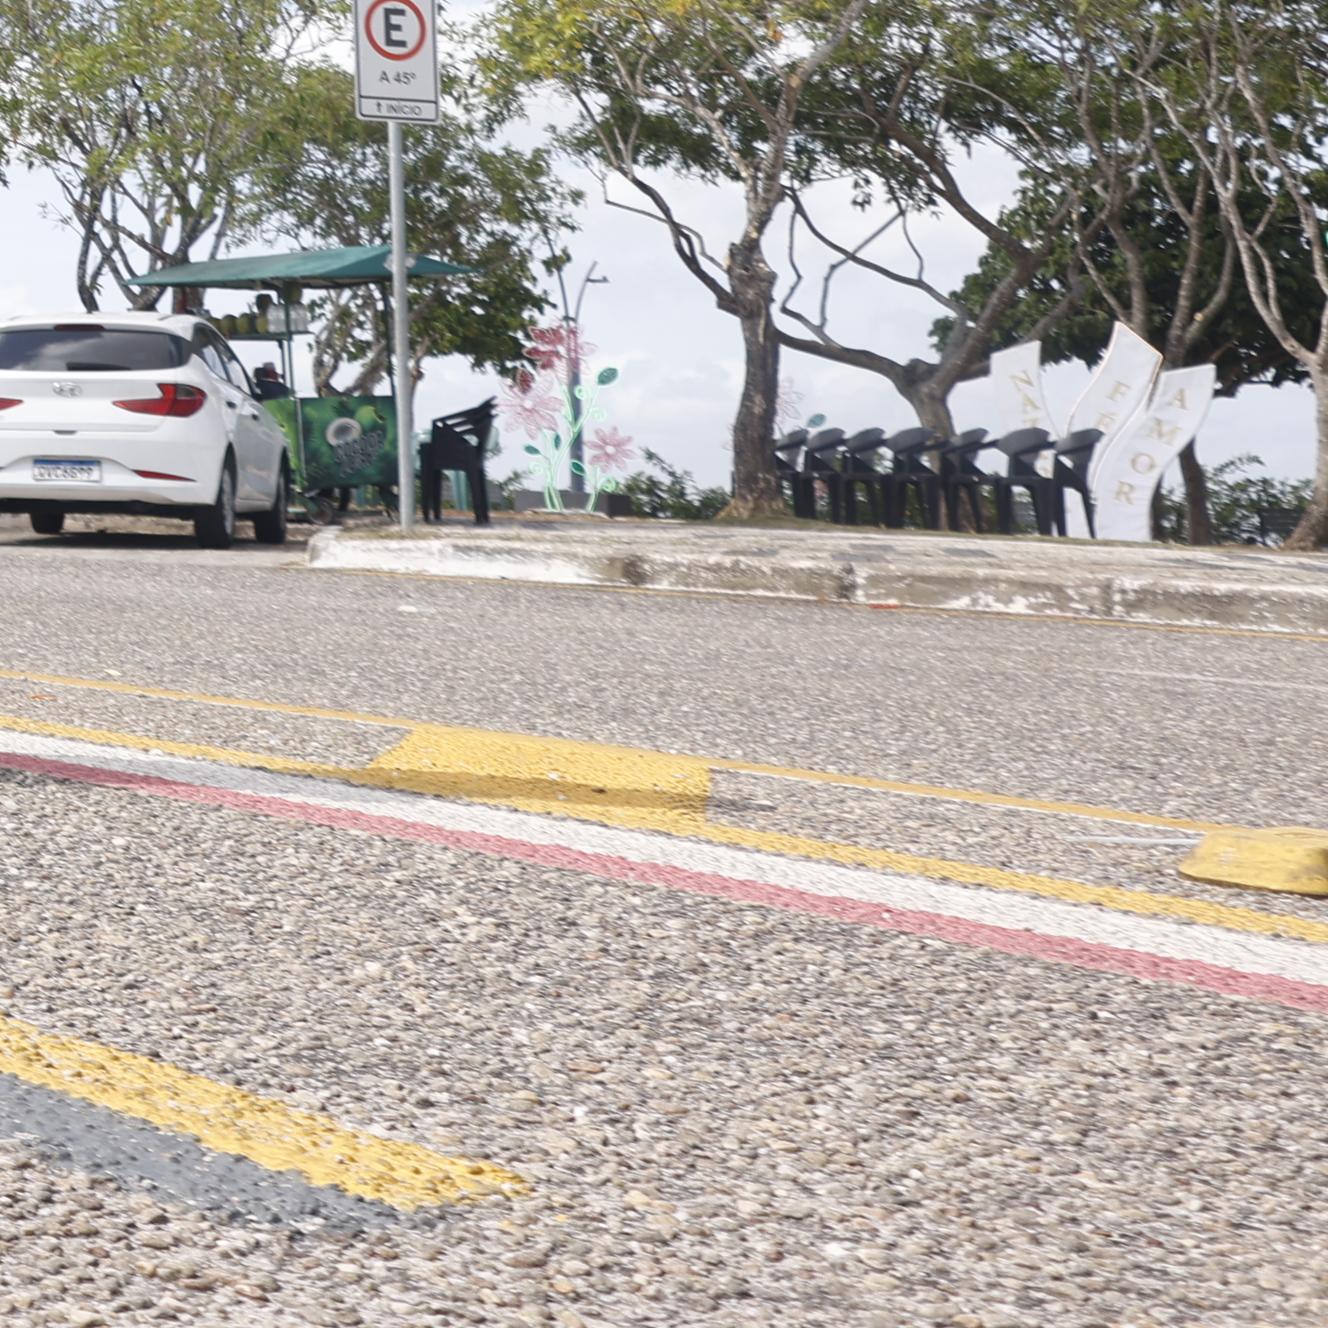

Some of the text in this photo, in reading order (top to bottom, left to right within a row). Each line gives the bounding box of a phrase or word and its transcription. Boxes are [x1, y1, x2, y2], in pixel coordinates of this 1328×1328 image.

[384, 7, 407, 48] E
[379, 70, 391, 84] A
[1112, 387, 1189, 506] AMOR
